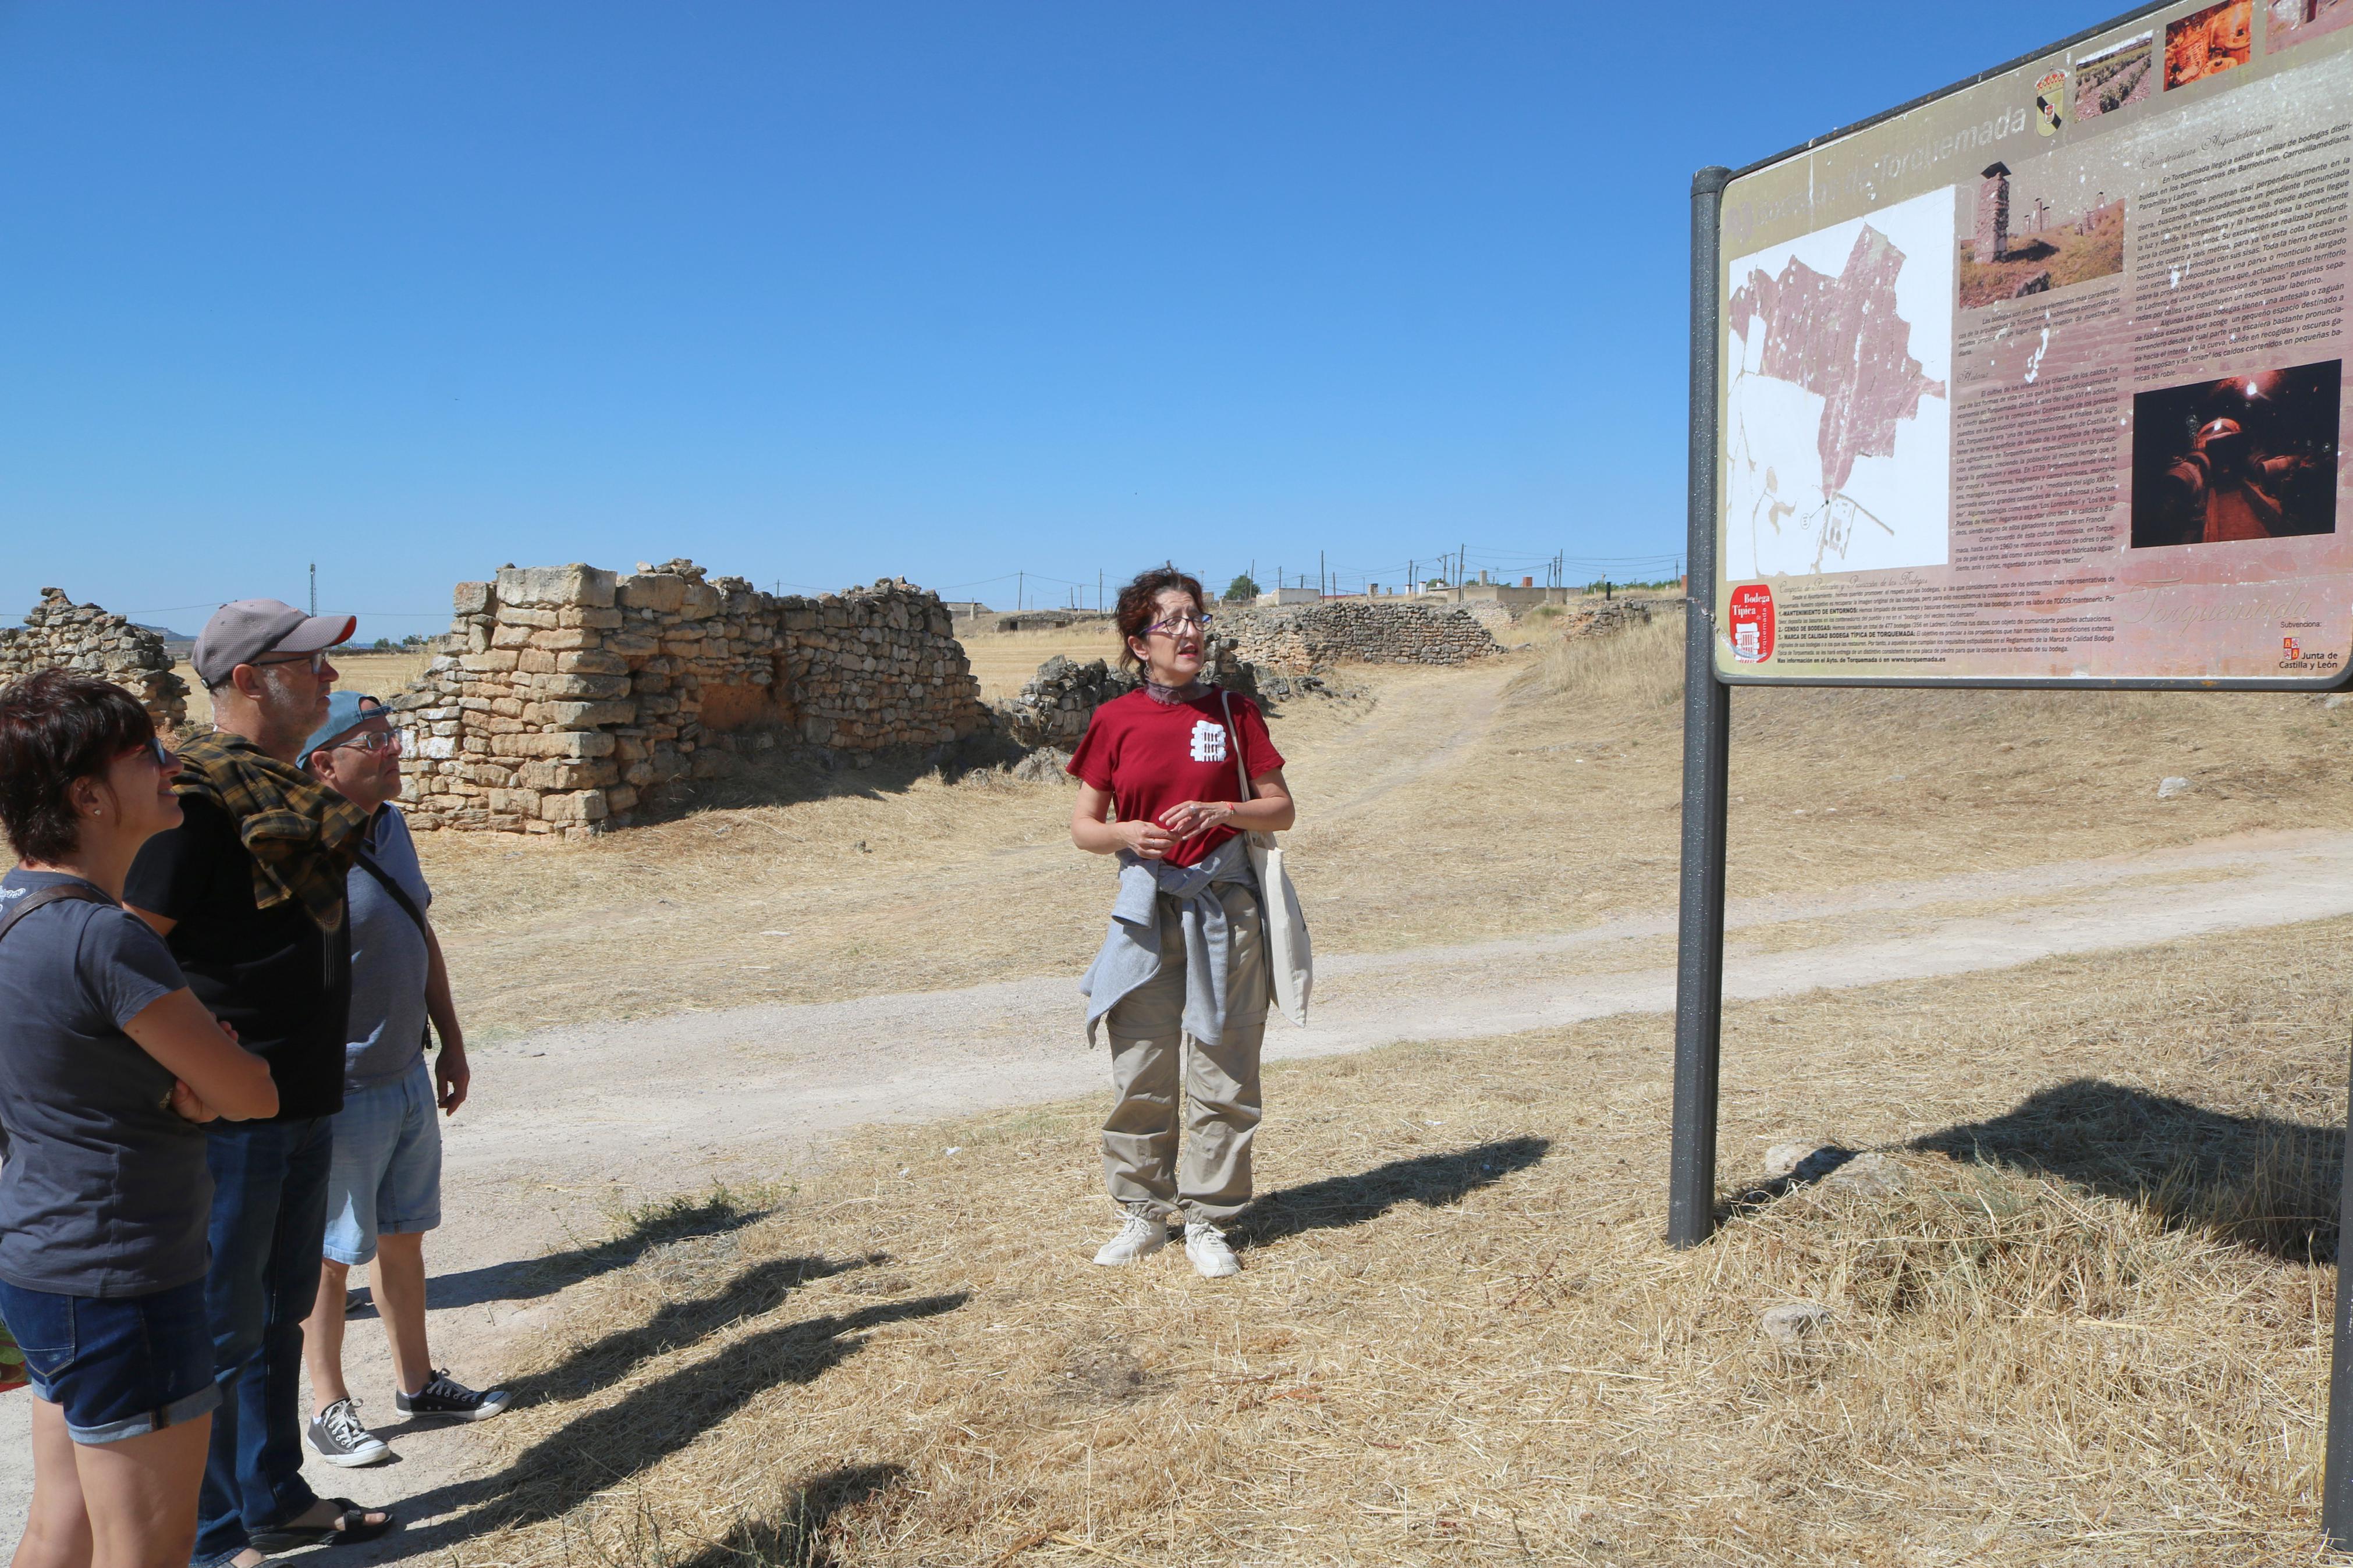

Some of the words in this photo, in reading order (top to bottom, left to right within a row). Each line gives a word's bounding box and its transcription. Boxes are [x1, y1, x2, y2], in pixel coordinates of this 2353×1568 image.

[2139, 190, 2158, 201] buidas
[2180, 170, 2225, 189] barrios-cuevas
[2227, 168, 2235, 176] de
[2238, 155, 2280, 172] Barrionuevo,
[2283, 135, 2351, 159] Carrovillamediana,
[2163, 176, 2170, 184] En
[2171, 165, 2209, 181] Torquemada
[2211, 158, 2226, 169] llegó
[2234, 151, 2254, 163] existir
[2256, 148, 2263, 157] un
[2266, 142, 2285, 154] millar
[2287, 138, 2296, 147] de
[2298, 129, 2329, 144] bodegas
[2138, 222, 2155, 232] tierra,
[2157, 212, 2187, 226] buscando
[2189, 195, 2251, 218] intencionadamente
[2254, 192, 2262, 200] un
[2265, 182, 2300, 198] pendiente
[2304, 168, 2350, 188] pronunciada
[2138, 198, 2166, 211] Paramillo
[2173, 190, 2198, 201] Ladrero.
[2161, 205, 2177, 215] Estas
[2180, 197, 2205, 209] bodegas
[2208, 189, 2237, 204] penetran
[2240, 182, 2253, 193] casi
[2256, 163, 2327, 190] perpendicularmente
[2330, 159, 2340, 168] en
[2135, 314, 2151, 322] radas
[2153, 311, 2162, 321] por
[2164, 307, 2181, 317] calles
[2183, 304, 2194, 314] que
[2196, 296, 2232, 310] constituyen
[2244, 284, 2288, 299] espectacular
[2289, 277, 2323, 289] laberinto.
[2144, 300, 2168, 310] Ladrero,
[2192, 289, 2217, 300] singular
[2219, 282, 2247, 294] sucesión
[2290, 265, 2323, 279] paralelas
[2325, 261, 2345, 270] sepa-
[2160, 317, 2184, 328] Algunas
[2194, 311, 2211, 319] éstas
[2213, 305, 2240, 316] bodegas
[2242, 300, 2263, 310] tienen
[2265, 297, 2277, 305] una
[2279, 290, 2309, 302] antesala
[2317, 283, 2344, 294] zaguán
[2134, 341, 2166, 353] merendero
[2167, 336, 2185, 346] desde
[2188, 334, 2194, 342] el
[2195, 331, 2208, 340] cual
[2209, 329, 2226, 339] parte
[2228, 326, 2240, 334] una
[2242, 320, 2270, 331] escalera
[2272, 314, 2303, 325] bastante
[2305, 305, 2344, 321] pronuncia-
[2143, 331, 2164, 340] fábrica
[2166, 325, 2194, 336] excavada
[2195, 322, 2207, 332] que
[2209, 318, 2227, 327] acoge
[2241, 309, 2270, 322] pequeño
[2272, 303, 2299, 314] espacio
[2301, 296, 2337, 308] destinado
[1732, 605, 1756, 618] Típica
[1744, 592, 1770, 604] Bodega
[2310, 662, 2315, 670] y
